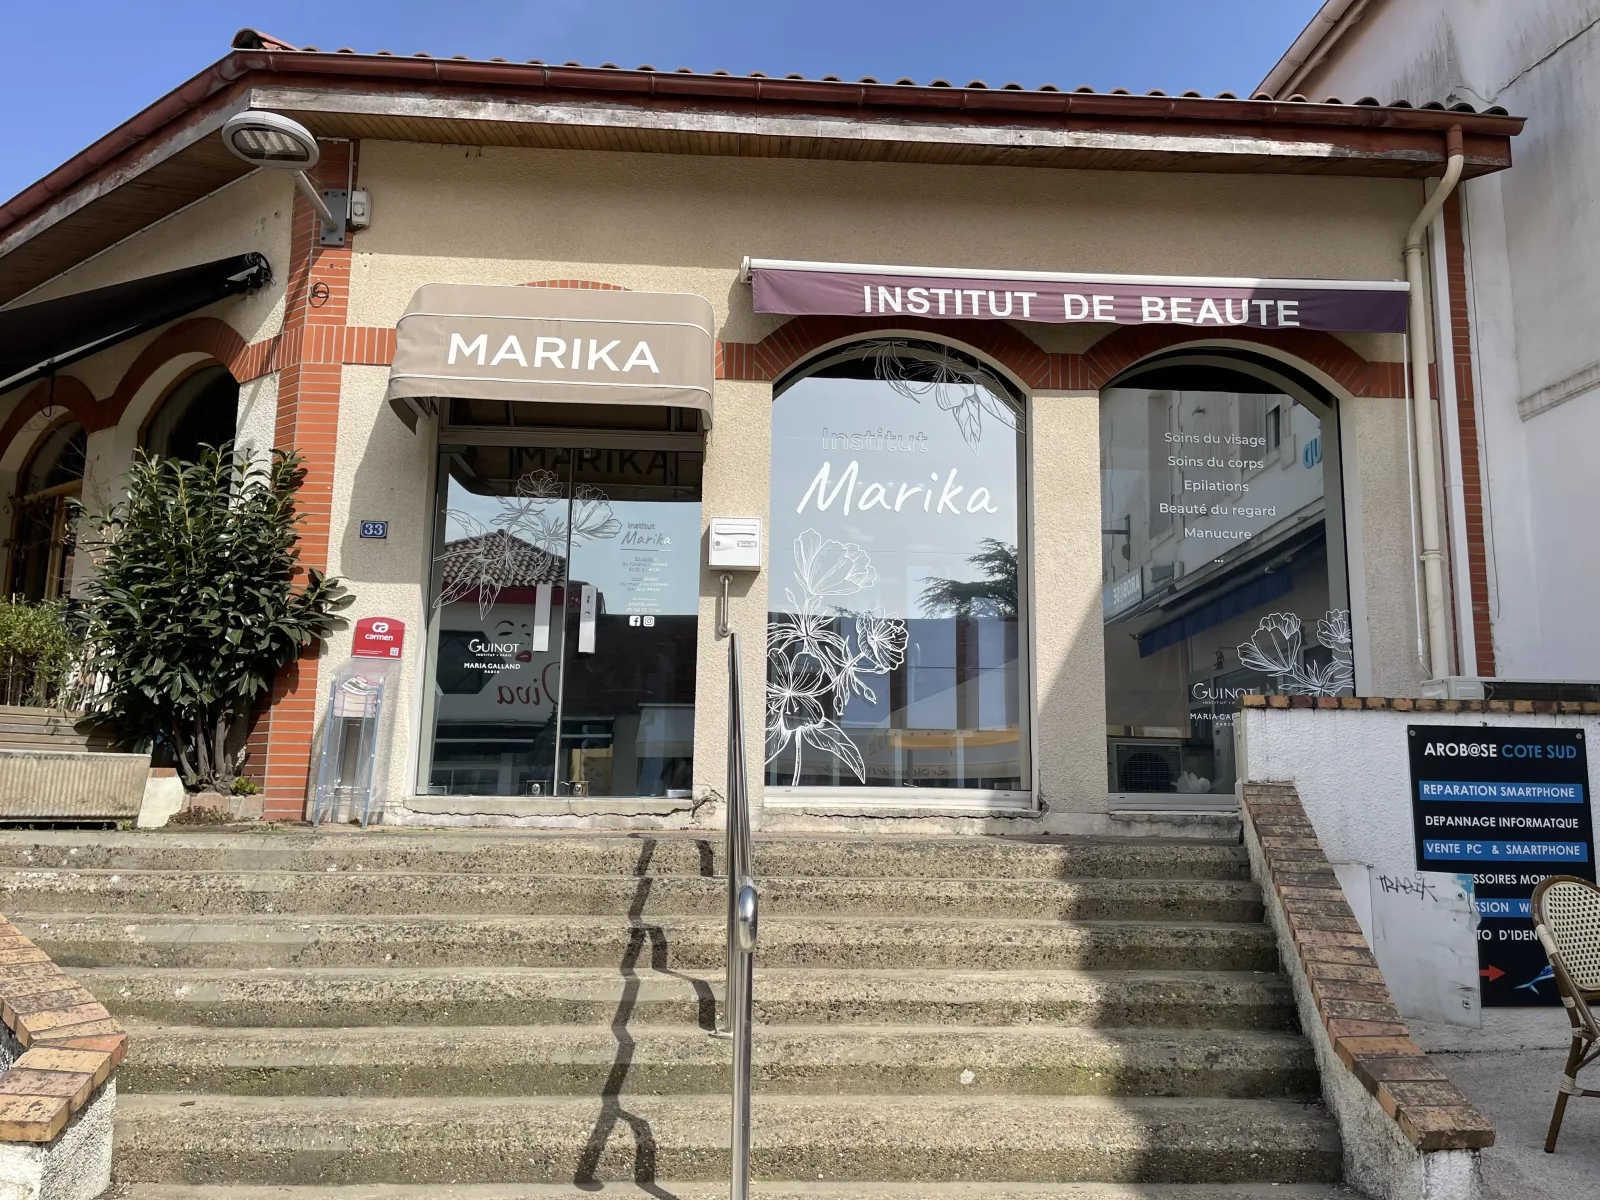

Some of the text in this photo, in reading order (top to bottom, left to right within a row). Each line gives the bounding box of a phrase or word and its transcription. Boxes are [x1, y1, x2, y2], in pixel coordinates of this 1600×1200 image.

[863, 285, 1300, 327] INSTITUT DE BEAUTE
[447, 332, 660, 373] MARIKA
[822, 427, 928, 453] Institut
[1164, 432, 1266, 448] Soins du visage
[1168, 456, 1264, 471] Soins du corps
[796, 460, 998, 516] Marika
[1184, 480, 1249, 493] Epilations
[1159, 503, 1276, 518] Beauté du regard
[364, 523, 384, 536] 33
[628, 522, 655, 530] Institut
[621, 531, 672, 545] Marika
[1184, 528, 1252, 540] Manucure
[364, 633, 394, 641] carmen
[468, 639, 520, 653] GUINOT
[1424, 743, 1577, 759] AROB@SE COTE SUD
[1423, 784, 1575, 798] REPARATION SMARTPHONE
[1425, 816, 1496, 827] DEPANNAGE
[1426, 843, 1580, 855] VENTE PC & SMARTPHONE
[1474, 874, 1517, 884] SSOIRES
[1519, 902, 1531, 913] W
[1499, 930, 1538, 940] D'IDEN
